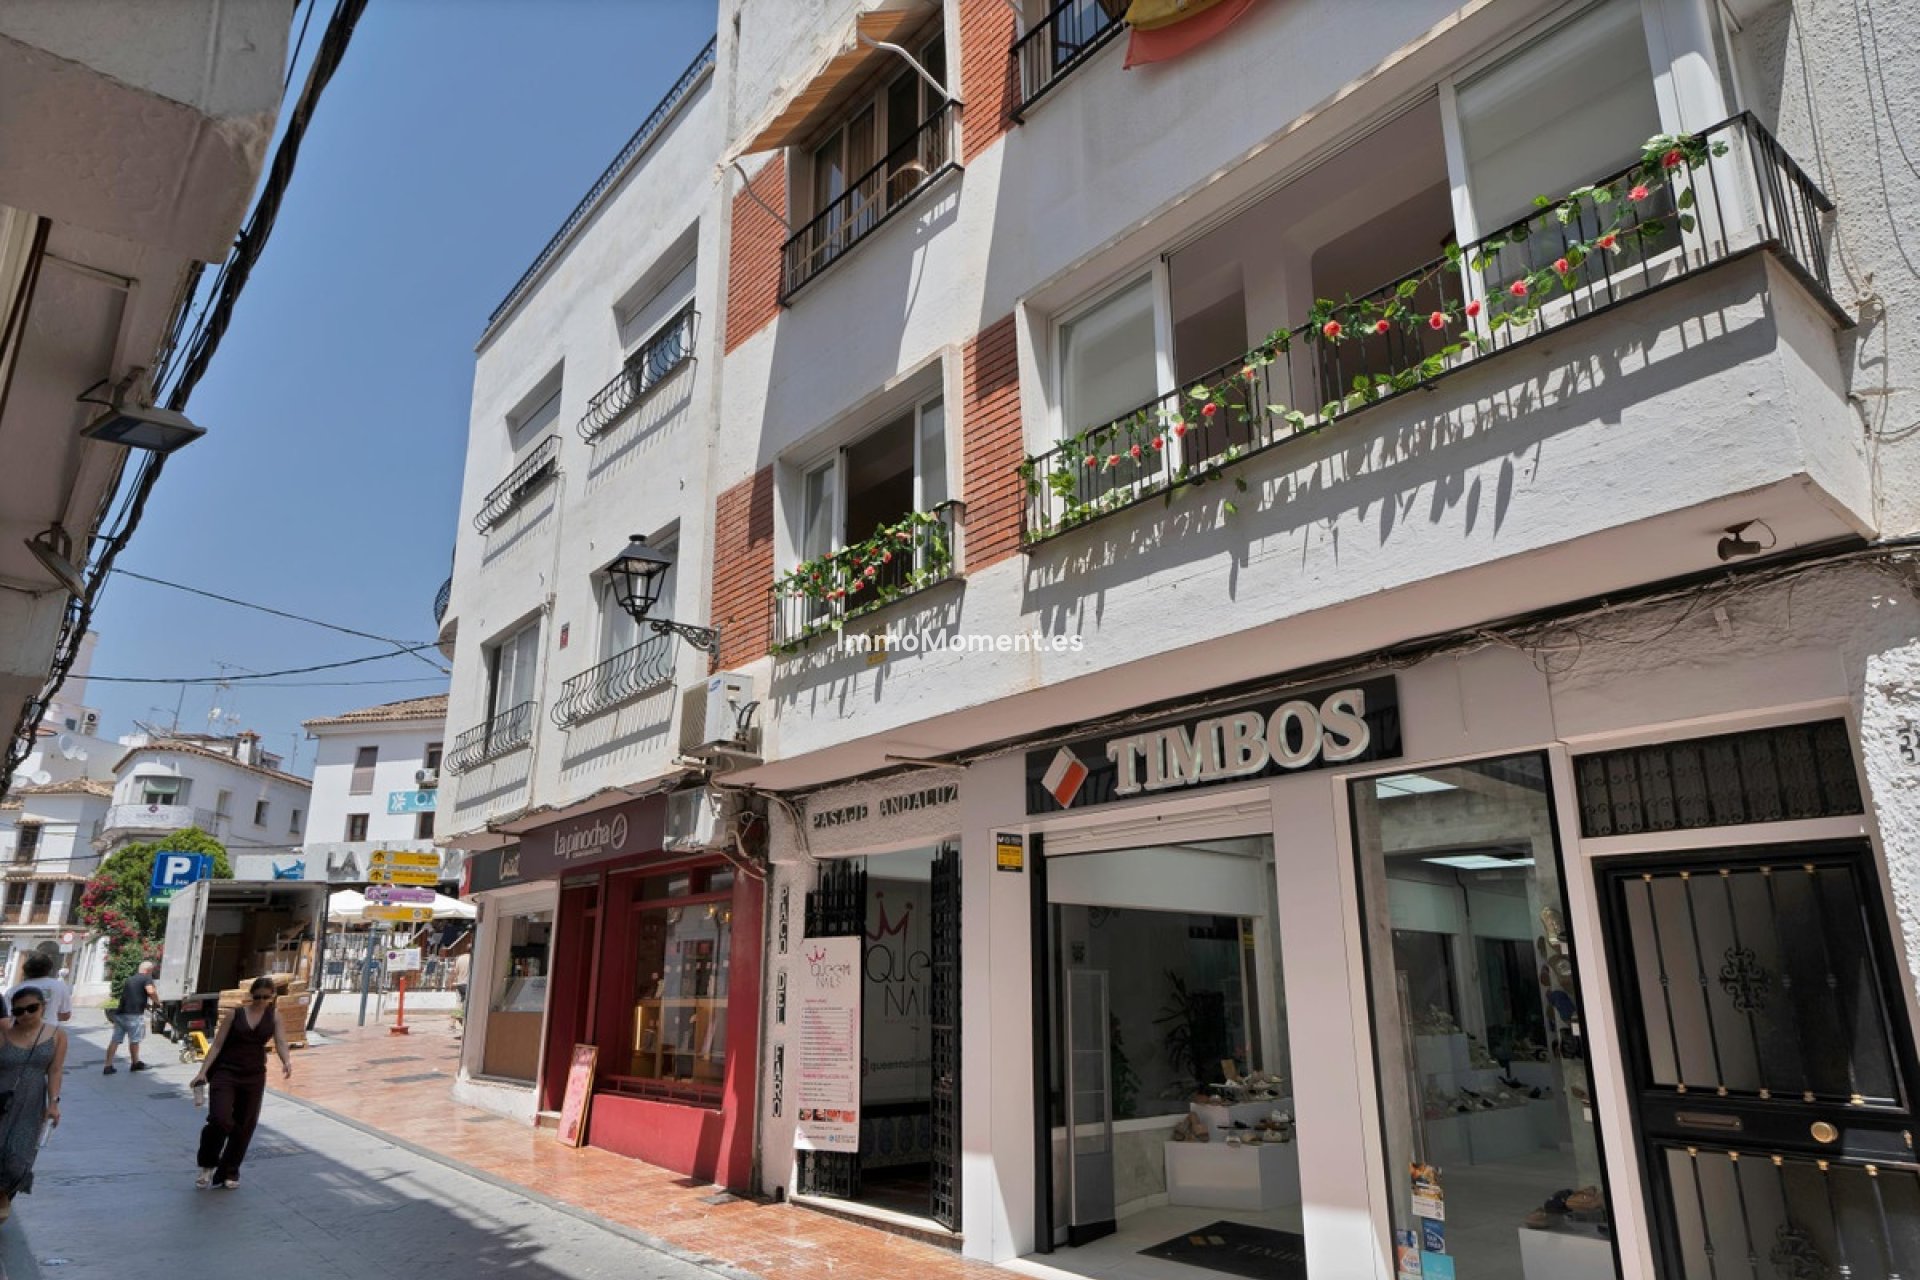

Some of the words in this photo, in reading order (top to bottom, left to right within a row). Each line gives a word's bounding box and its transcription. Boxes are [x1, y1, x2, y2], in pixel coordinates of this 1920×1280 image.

[1106, 688, 1370, 796] TIMBOS
[813, 803, 868, 829] PASAJE
[880, 783, 958, 816] ANDALUZ
[163, 856, 191, 884] P
